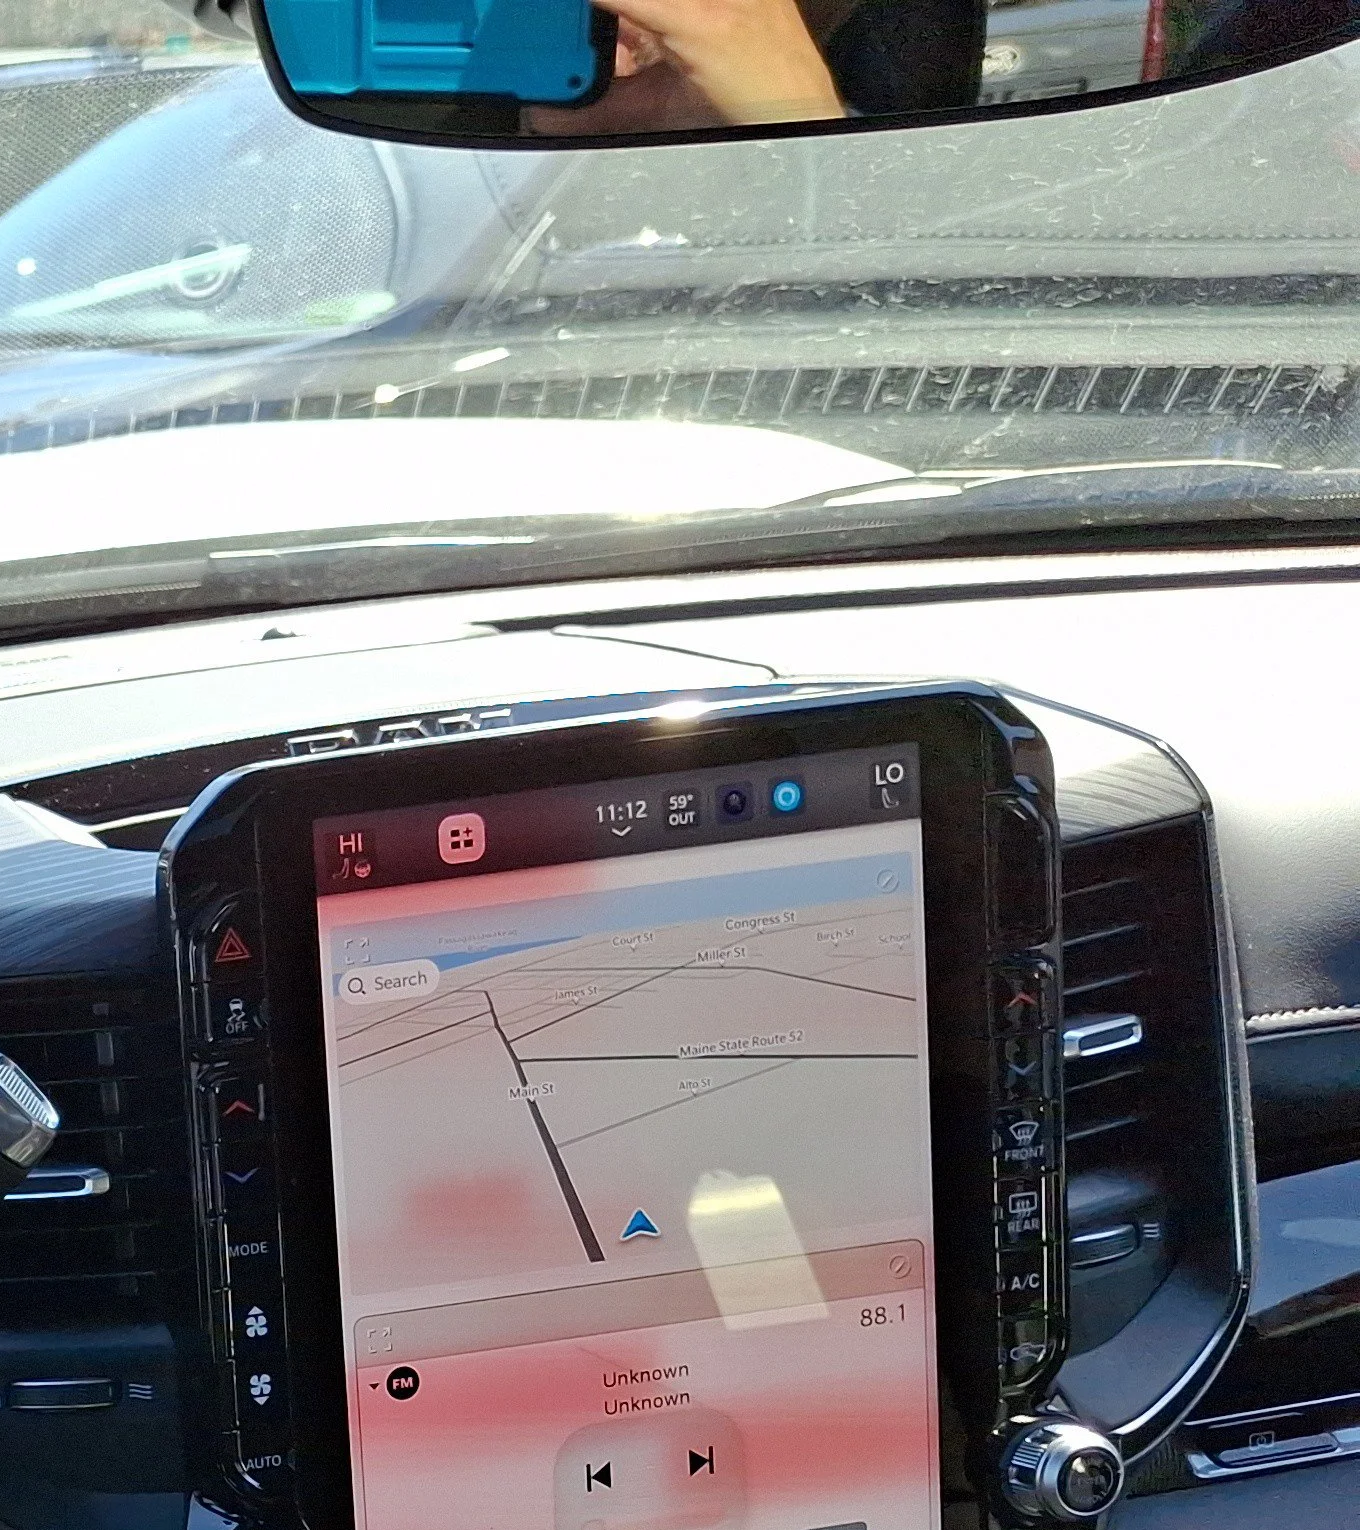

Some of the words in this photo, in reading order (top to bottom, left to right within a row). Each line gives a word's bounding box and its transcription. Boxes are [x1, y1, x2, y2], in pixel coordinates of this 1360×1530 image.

[875, 763, 904, 786] LO
[595, 800, 648, 824] 11:12
[668, 811, 695, 827] OUT
[339, 833, 363, 856] HI
[725, 913, 778, 932] Congress
[782, 911, 796, 924] St
[612, 934, 641, 947] Court
[642, 932, 654, 943] St
[816, 929, 843, 942] Birch
[845, 927, 855, 938] St
[696, 948, 729, 963] Miller
[731, 946, 746, 959] St
[373, 969, 428, 992] Search
[554, 987, 584, 1002] James
[585, 985, 598, 997] St
[225, 1020, 250, 1036] OFF
[679, 1042, 716, 1058] Maine
[718, 1038, 749, 1054] State
[750, 1034, 784, 1050] Route
[787, 1030, 804, 1044] 52
[508, 1084, 539, 1099] Main
[540, 1081, 555, 1096] St
[678, 1080, 698, 1091] Alto
[699, 1078, 711, 1089] St
[1004, 1144, 1044, 1161] FRONT
[1007, 1217, 1040, 1232] REAR
[228, 1241, 268, 1258] MODE
[1011, 1273, 1040, 1290] A/C
[860, 1304, 907, 1328] 88.1
[392, 1376, 413, 1390] FM
[603, 1362, 690, 1389] Unknown
[604, 1390, 691, 1417] Unknown
[246, 1454, 281, 1470] AUTO
